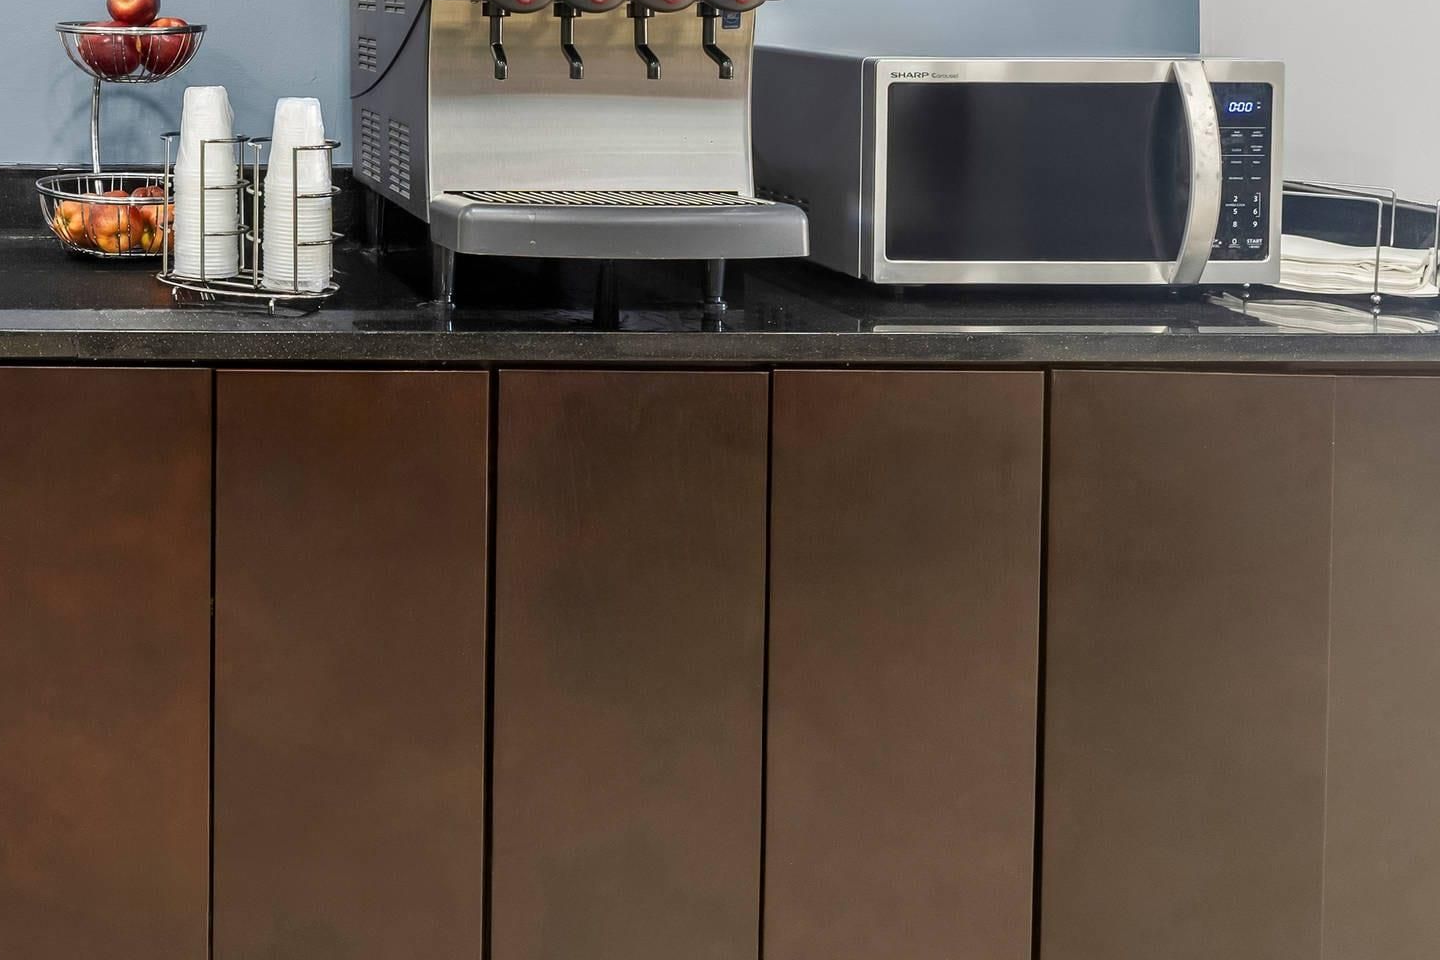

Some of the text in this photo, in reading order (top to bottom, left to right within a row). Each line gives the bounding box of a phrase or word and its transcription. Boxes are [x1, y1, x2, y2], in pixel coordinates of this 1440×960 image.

[890, 71, 929, 79] SHARP
[1233, 195, 1258, 203] 2 3
